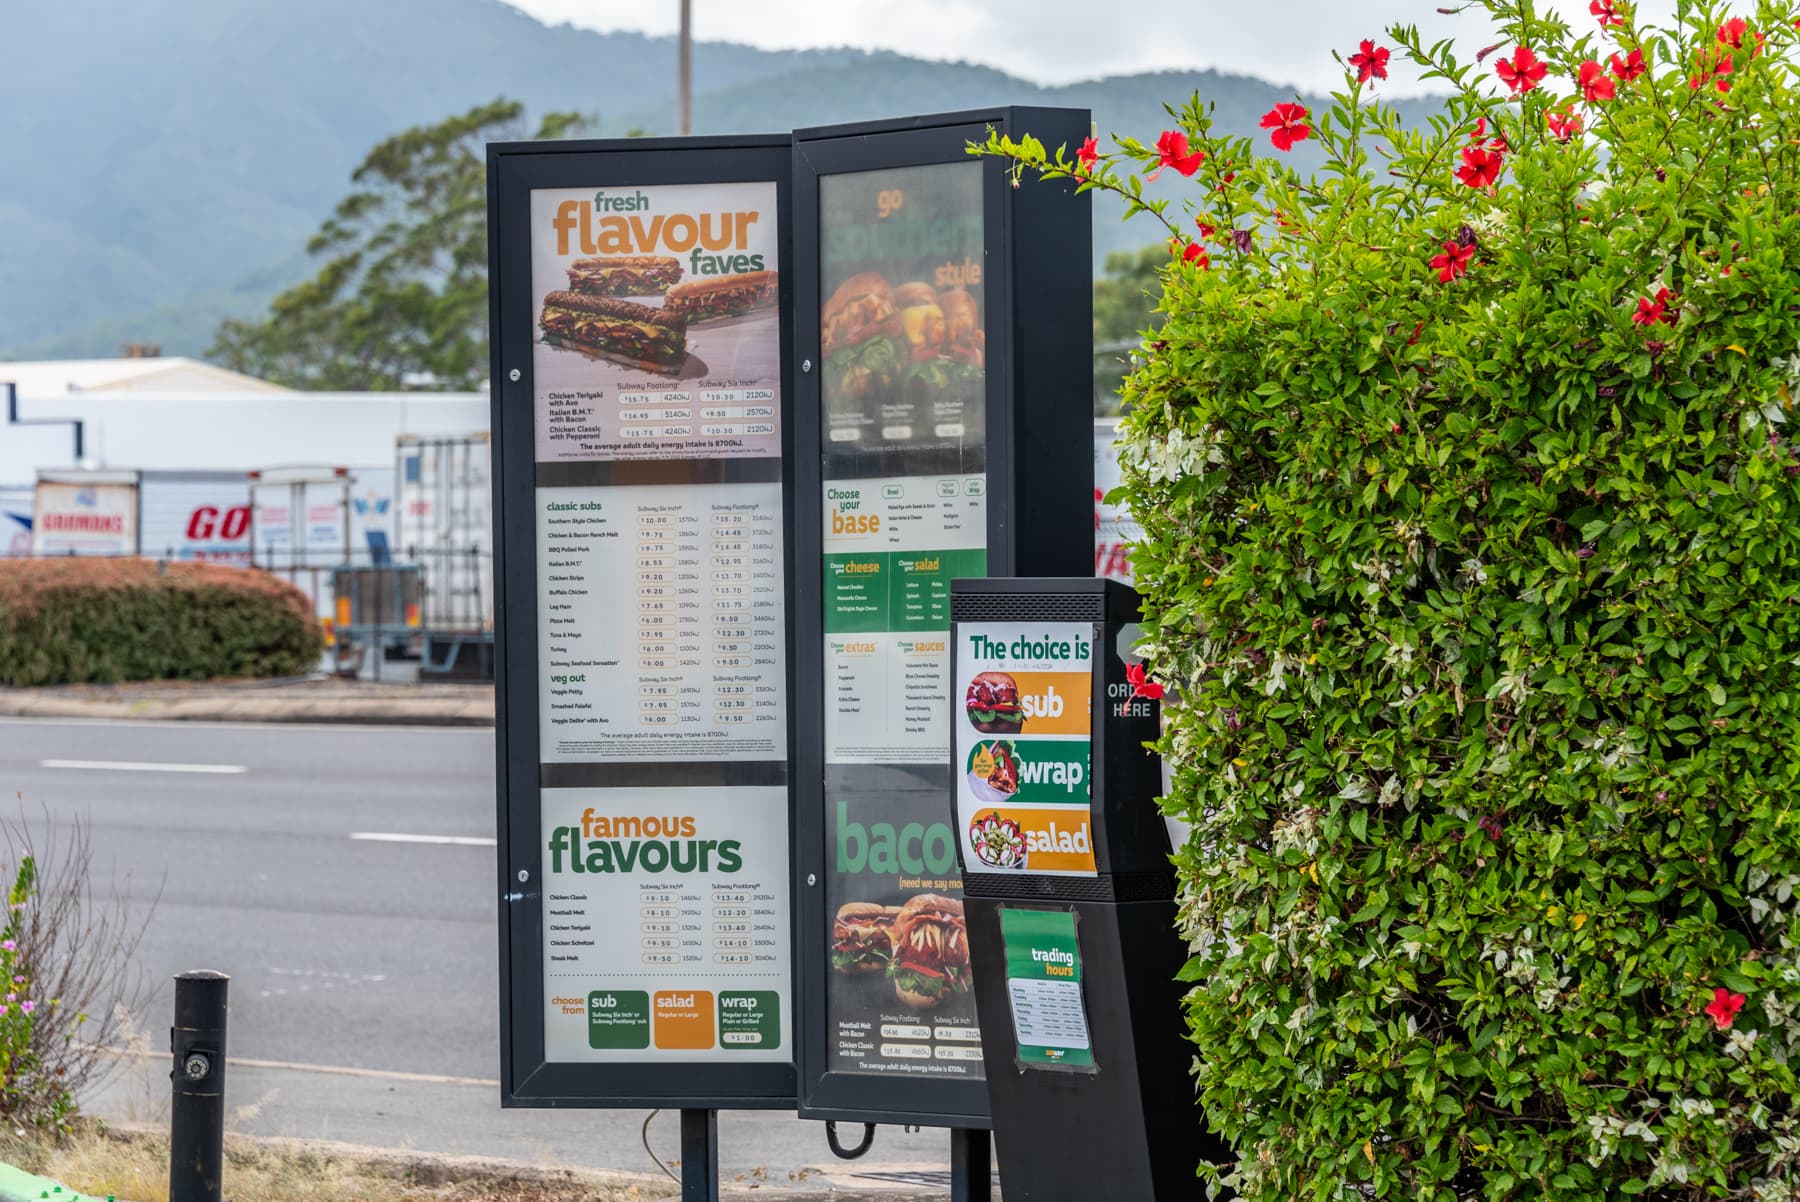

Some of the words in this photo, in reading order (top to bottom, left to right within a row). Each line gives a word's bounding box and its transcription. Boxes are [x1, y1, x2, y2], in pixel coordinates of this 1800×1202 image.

[594, 190, 649, 212] fresh
[878, 190, 903, 218] go
[553, 200, 760, 256] flavour
[690, 248, 765, 275] faves
[935, 256, 981, 287] style
[617, 382, 645, 390] Subway
[576, 392, 603, 400] Teriyaki
[642, 441, 660, 450] daily
[661, 442, 684, 451] energy
[828, 488, 860, 500] Choose
[546, 501, 578, 511] classic
[580, 500, 602, 510] subs
[840, 500, 860, 512] your
[832, 508, 880, 534] base
[846, 561, 880, 573] cheese
[914, 558, 939, 570] salad
[845, 642, 875, 652] extras
[914, 641, 945, 652] sauces
[970, 635, 1006, 660] The
[1010, 634, 1070, 660] choice
[1074, 634, 1090, 660] is
[551, 675, 567, 685] veg
[569, 674, 586, 682] out
[1108, 683, 1138, 698] ORD
[1022, 686, 1064, 718] sub
[1020, 761, 1084, 793] wrap
[581, 808, 696, 838] famous
[836, 800, 962, 875] baco
[1024, 822, 1090, 854] salad
[548, 826, 742, 874] flavours
[899, 876, 920, 890] (need
[921, 880, 932, 888] we
[934, 880, 948, 891] say
[1032, 948, 1073, 966] trading
[1046, 963, 1073, 977] hours
[552, 996, 584, 1005] choose
[591, 994, 617, 1008] sub
[657, 994, 695, 1008] salad
[721, 996, 758, 1011] wrap
[562, 1006, 585, 1015] from
[880, 1014, 898, 1023] Subway
[934, 1016, 952, 1024] Subway
[899, 1063, 910, 1072] daily
